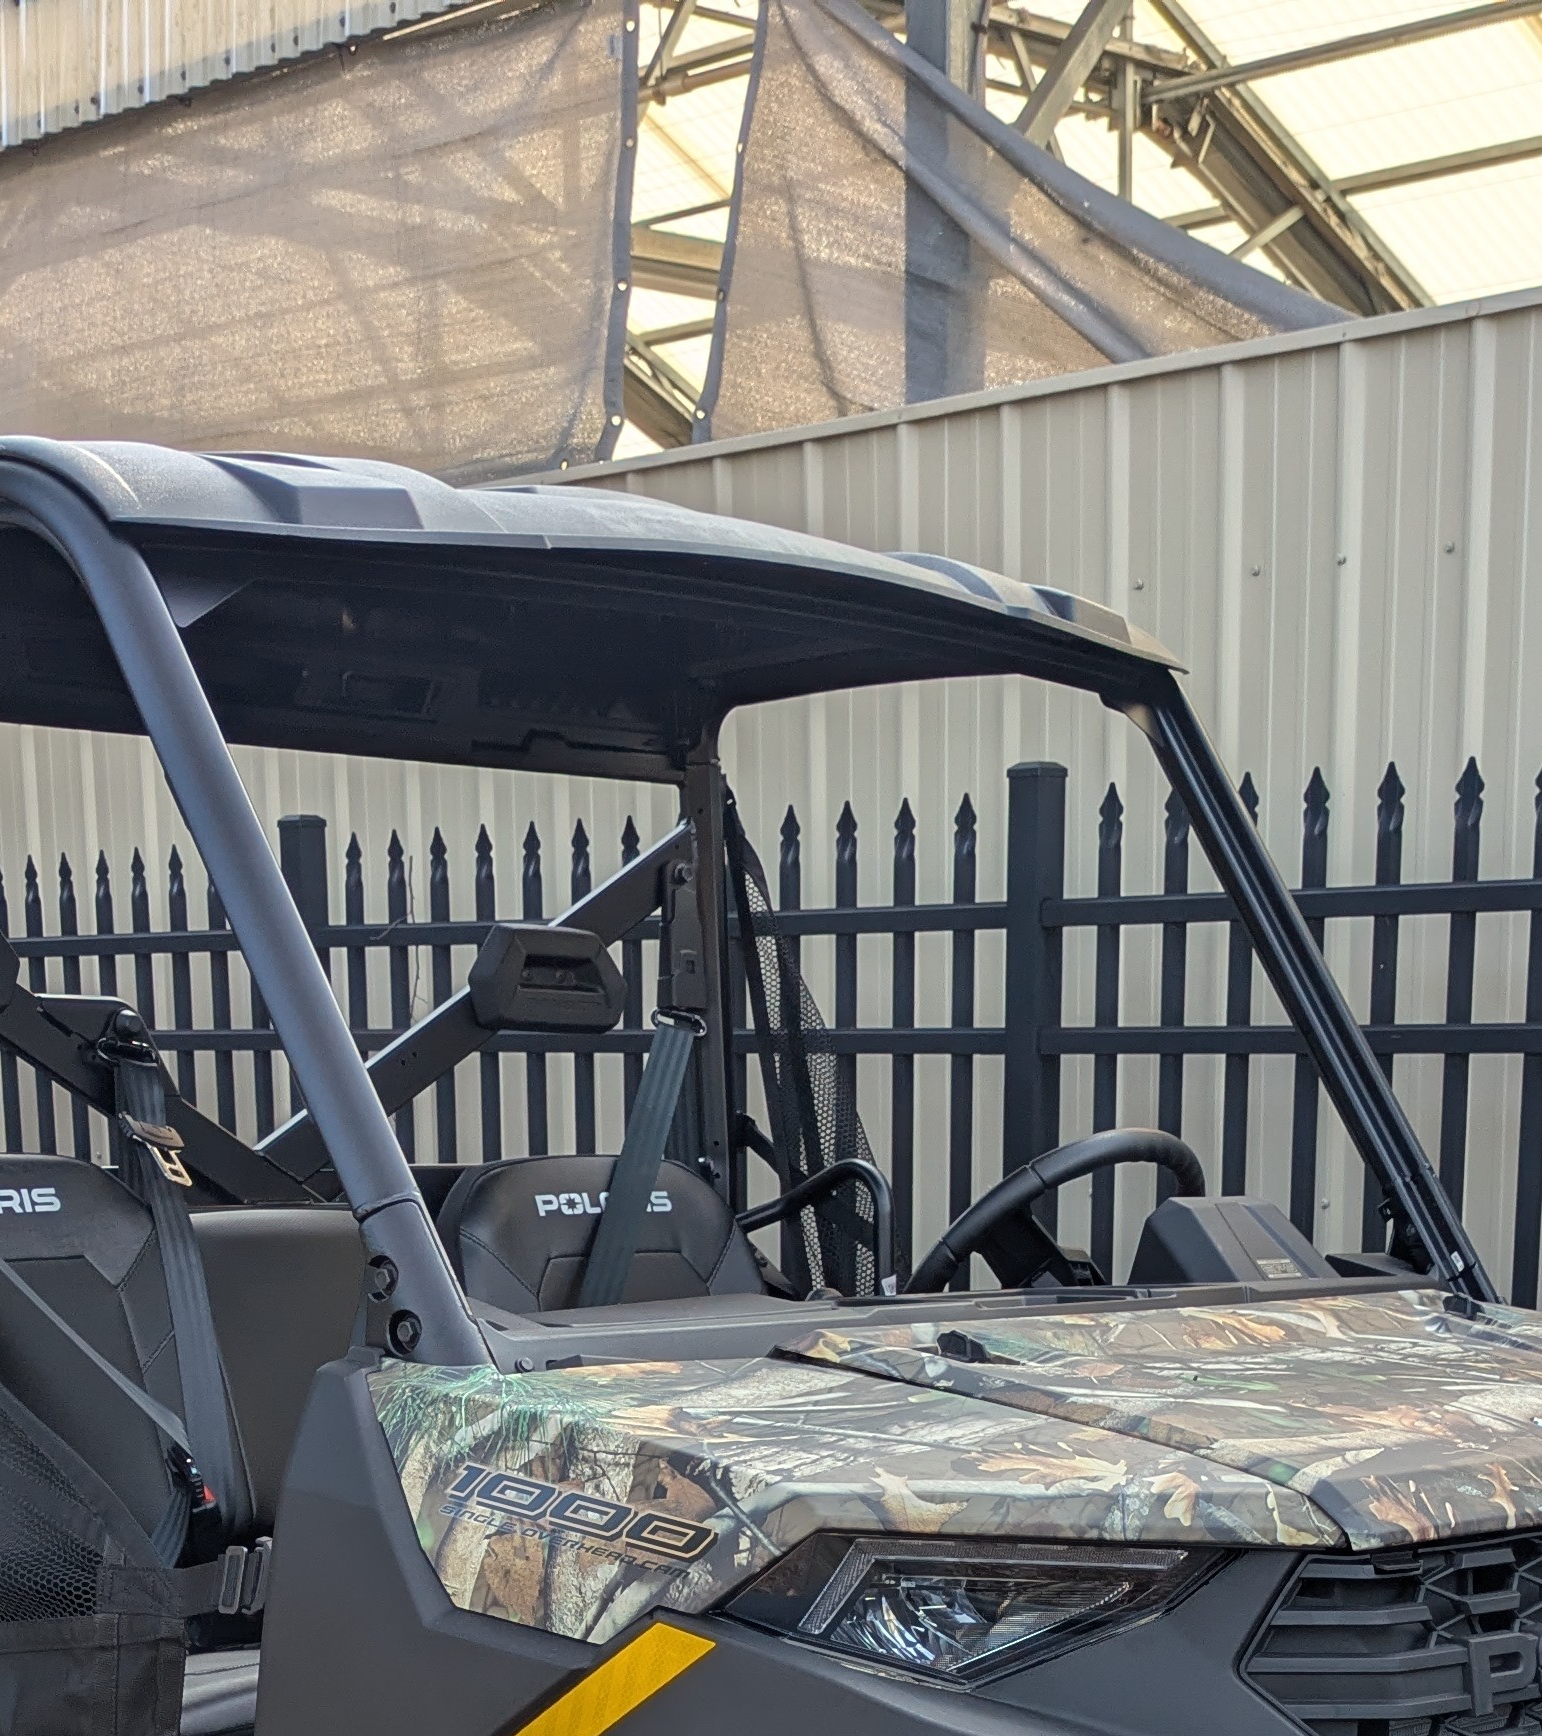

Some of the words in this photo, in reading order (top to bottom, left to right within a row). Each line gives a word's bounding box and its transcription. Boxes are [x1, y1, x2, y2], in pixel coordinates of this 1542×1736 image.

[439, 1503, 517, 1533] SINGLE
[521, 1527, 637, 1565] OVERHEAD
[636, 1558, 690, 1579] CAM
[445, 1462, 719, 1564] 1000
